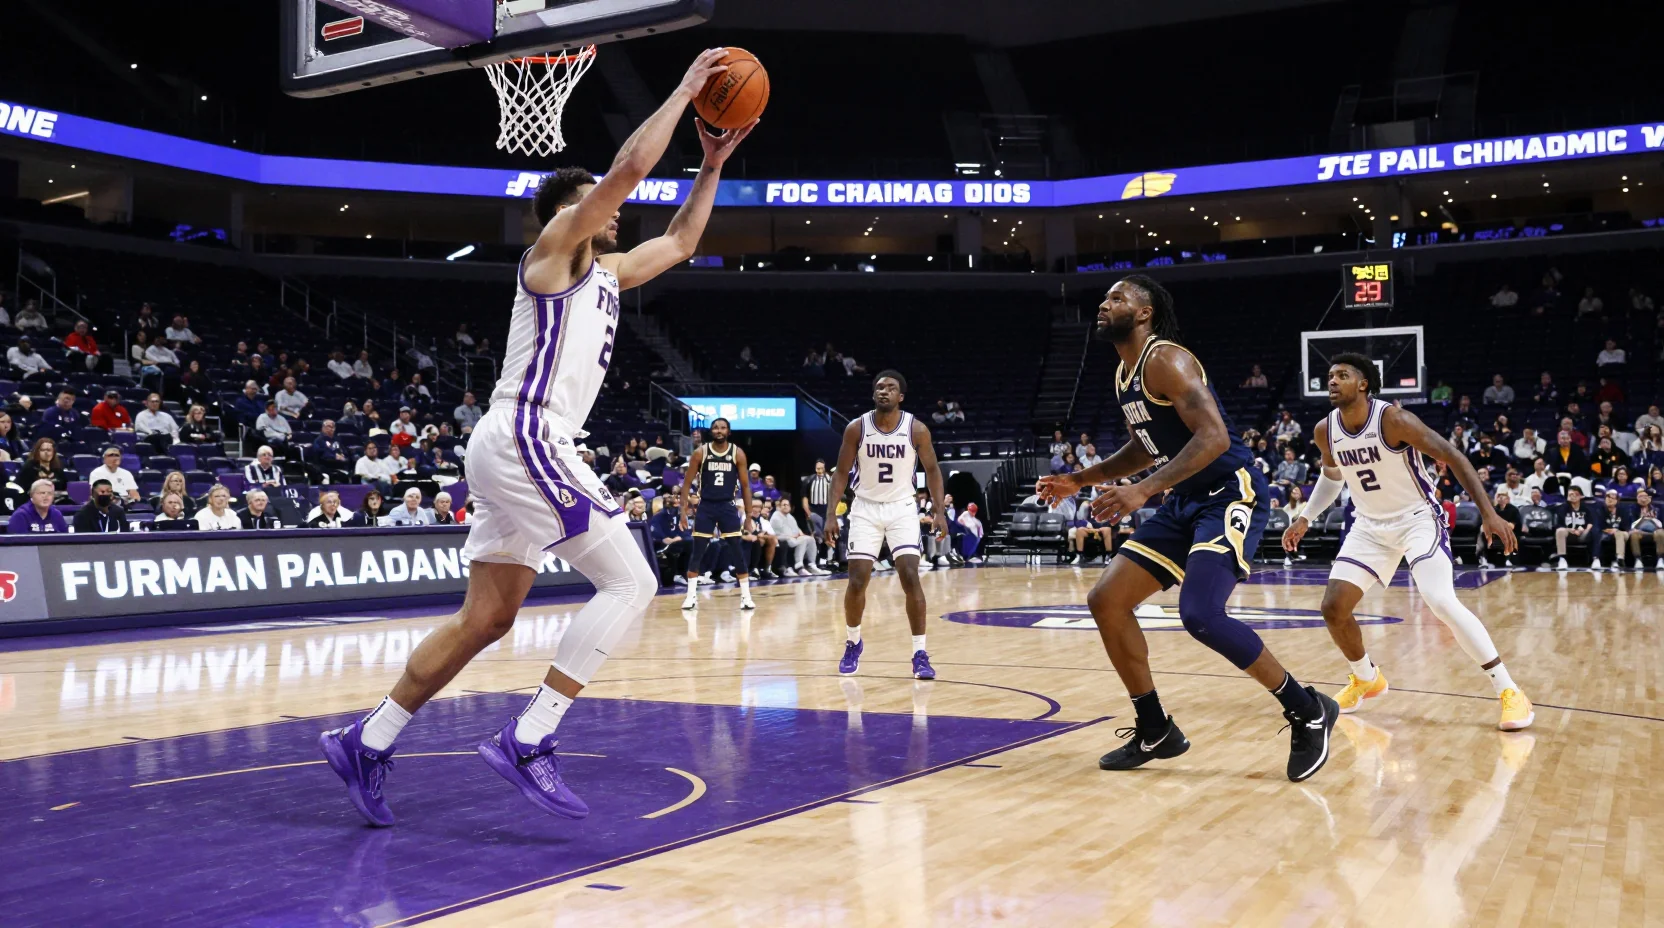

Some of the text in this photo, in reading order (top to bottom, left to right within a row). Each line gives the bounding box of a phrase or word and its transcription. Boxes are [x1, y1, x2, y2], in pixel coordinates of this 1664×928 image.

[1379, 147, 1445, 173] PAIL
[766, 183, 818, 203] FOC
[827, 181, 953, 204] CHAIMAG
[1354, 281, 1382, 302] 29
[598, 324, 614, 371] 2
[866, 444, 905, 459] UNCN
[1336, 445, 1381, 466] UNCN
[714, 471, 724, 486] 2
[878, 462, 894, 483] 2
[1356, 469, 1381, 492] 2
[61, 555, 268, 601] FURMAN
